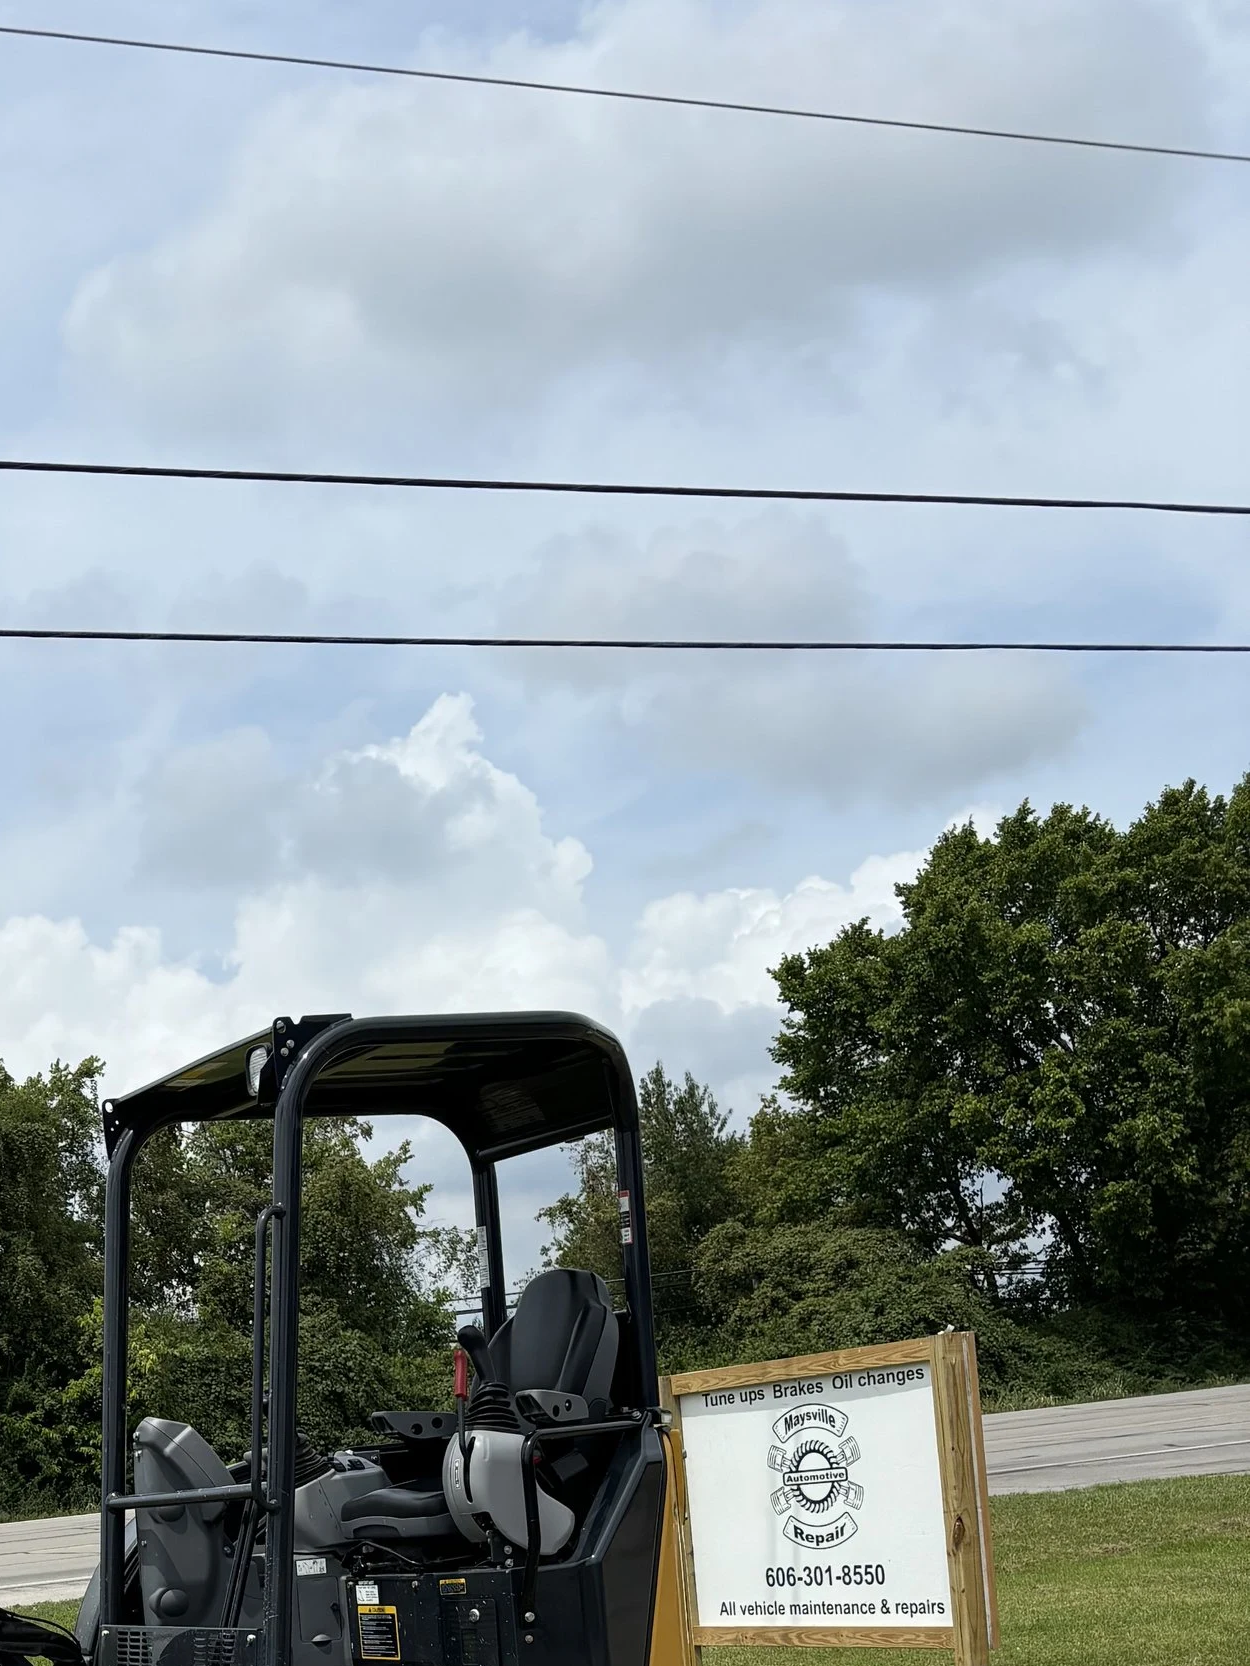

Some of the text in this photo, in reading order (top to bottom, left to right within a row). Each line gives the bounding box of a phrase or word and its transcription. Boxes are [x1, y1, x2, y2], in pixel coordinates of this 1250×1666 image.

[702, 1367, 924, 1407] Tune ups Brakes Oil changes
[783, 1408, 836, 1435] Maysville
[786, 1471, 845, 1483] Automotive
[792, 1522, 846, 1546] Repair
[766, 1564, 886, 1587] 606-301-8550
[719, 1599, 945, 1617] All vehicle maintenance & repairs
